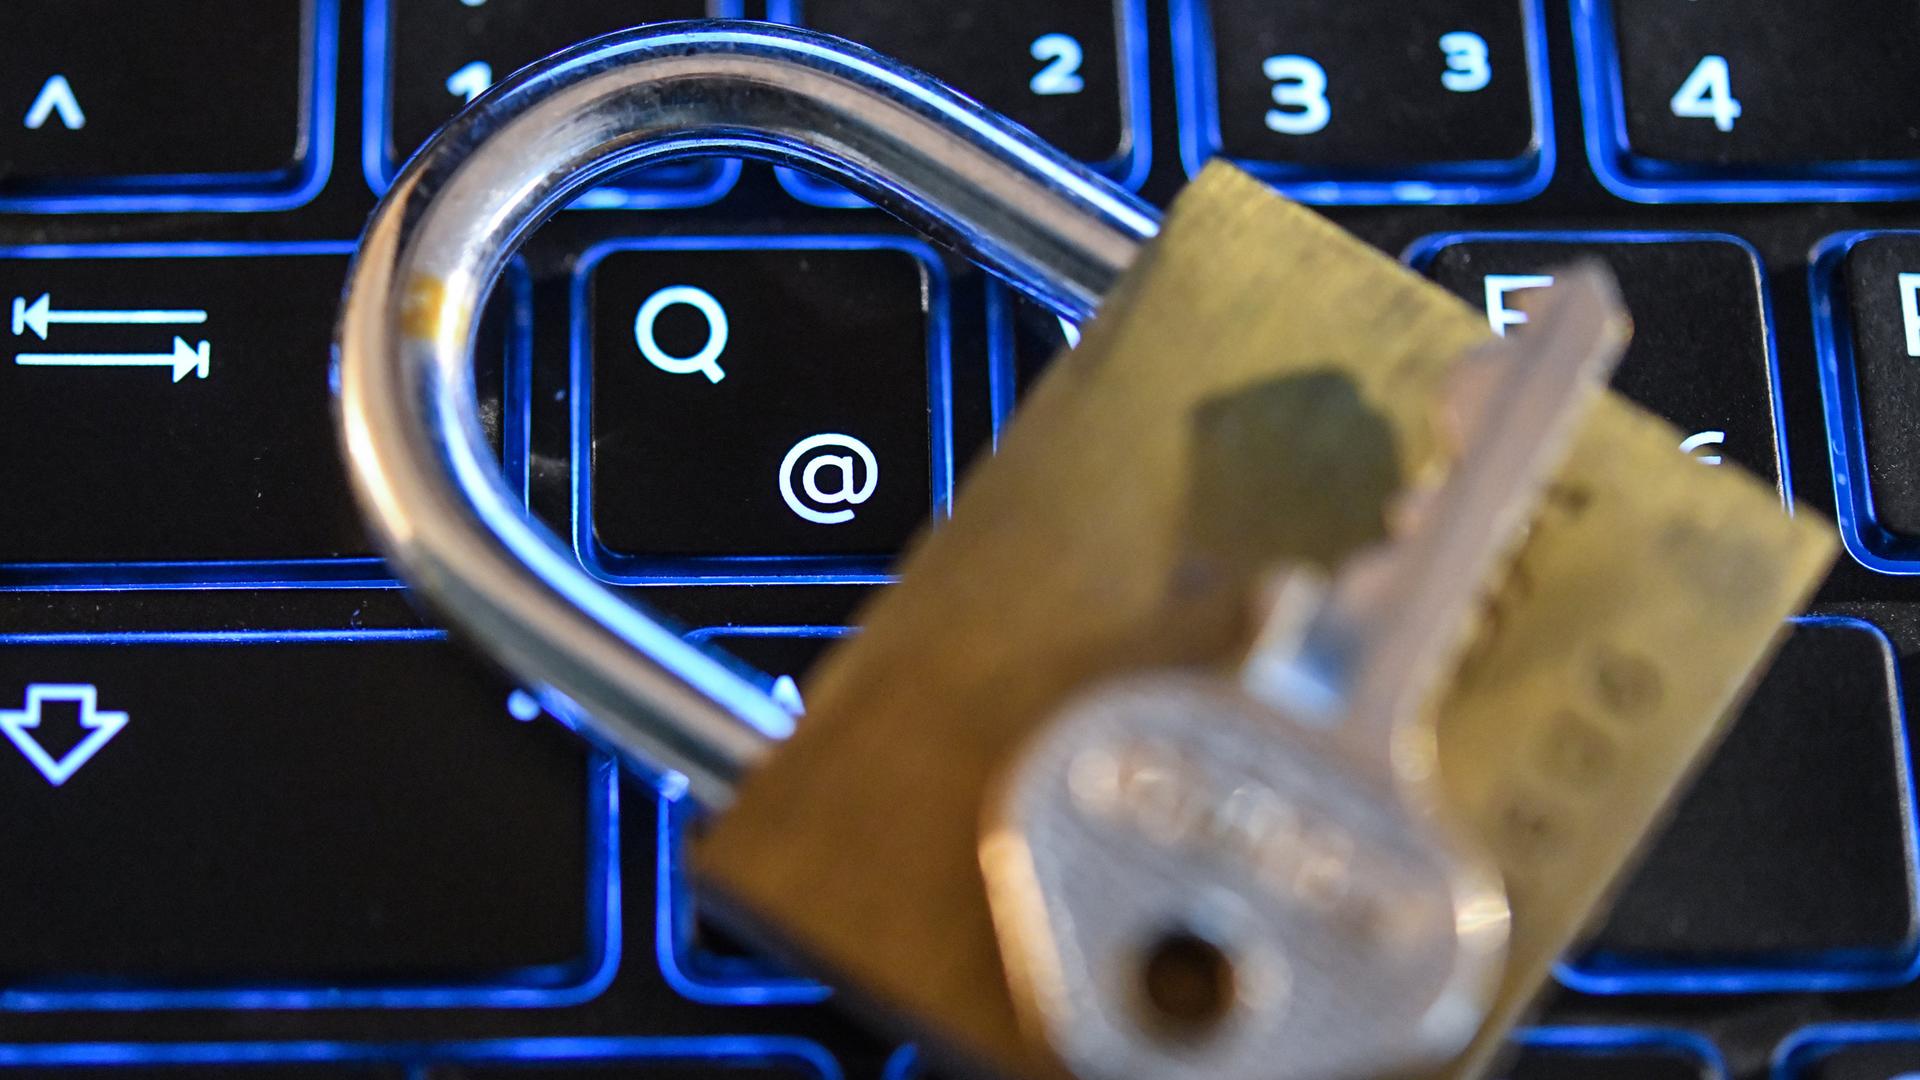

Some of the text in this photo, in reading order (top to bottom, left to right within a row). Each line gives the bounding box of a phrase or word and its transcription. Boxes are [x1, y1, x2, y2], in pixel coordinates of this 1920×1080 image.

[1030, 34, 1084, 95] 2
[1263, 55, 1331, 134] 3
[1439, 32, 1491, 91] 3
[1671, 55, 1741, 132] 4
[635, 285, 729, 384] Q
[779, 433, 878, 524] @
